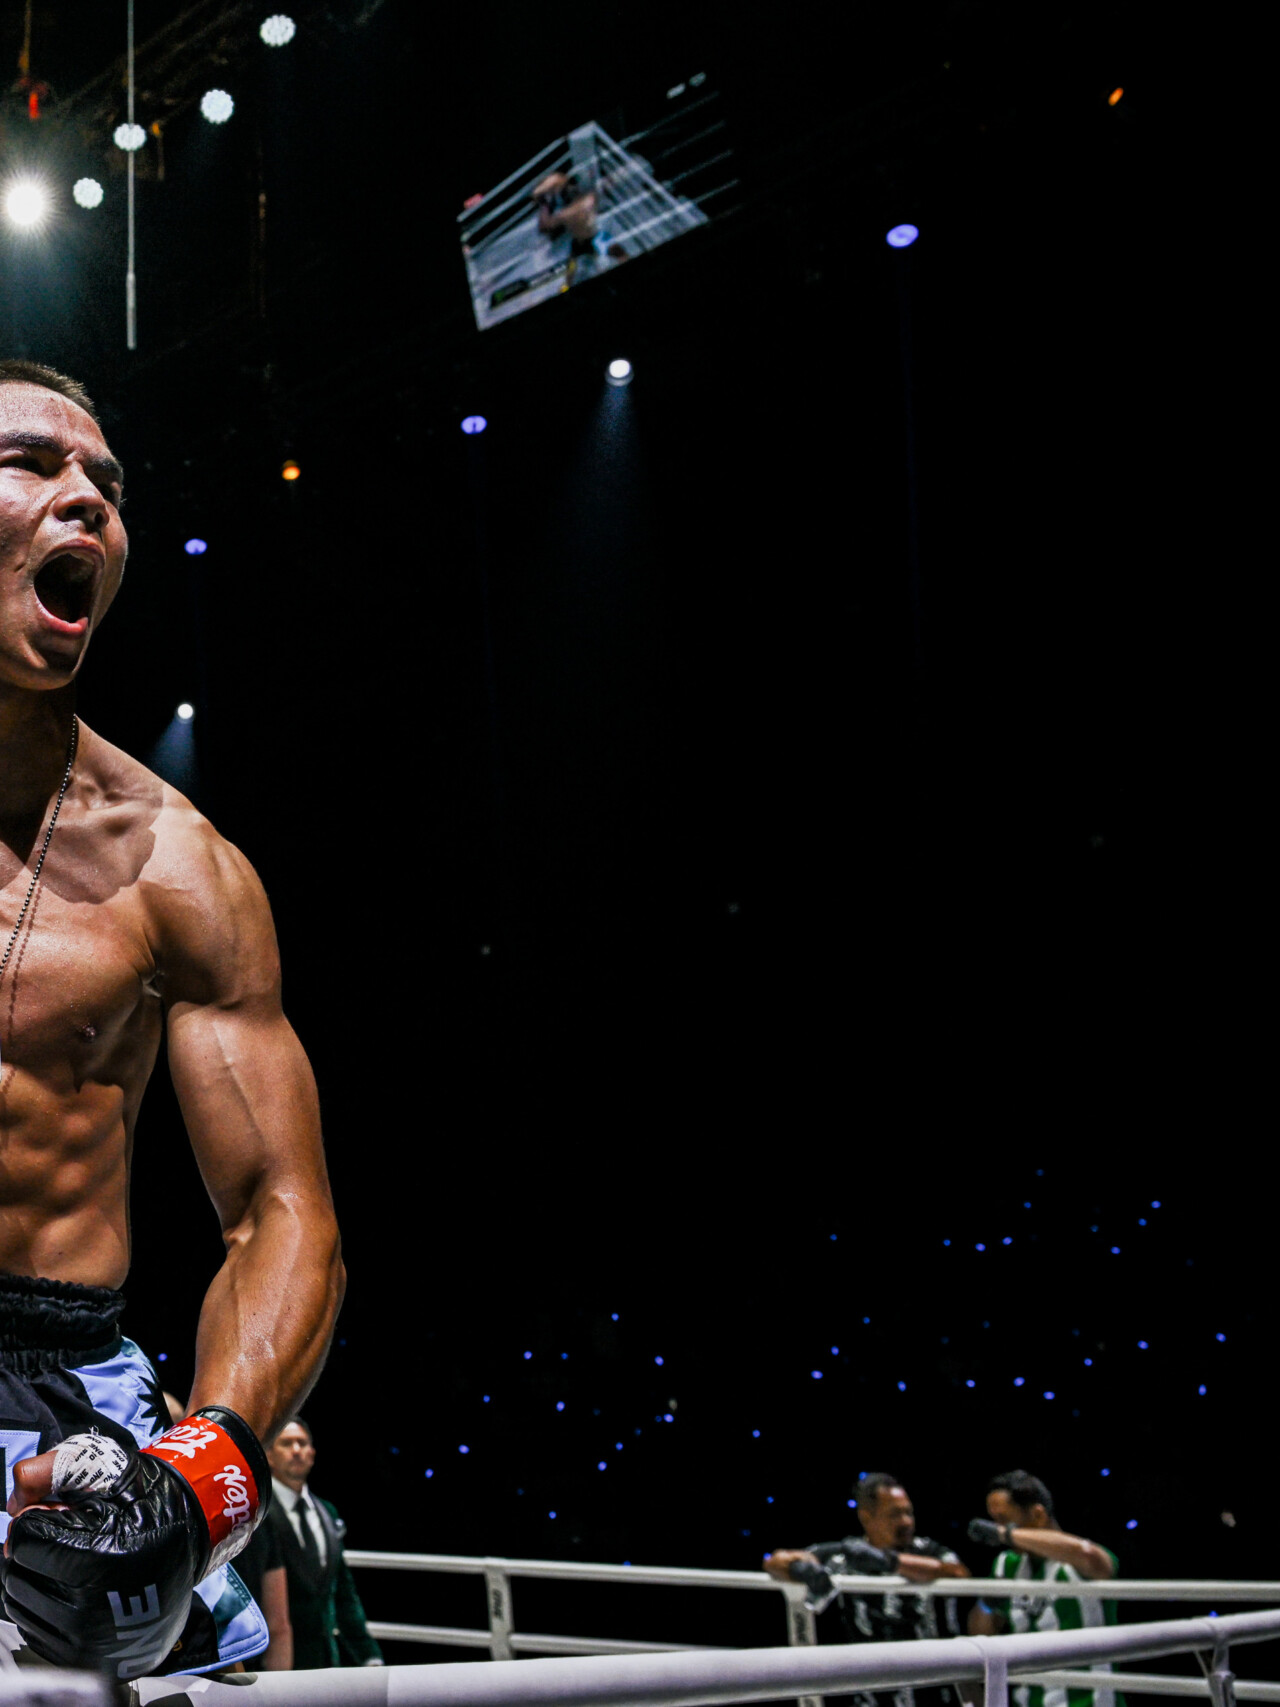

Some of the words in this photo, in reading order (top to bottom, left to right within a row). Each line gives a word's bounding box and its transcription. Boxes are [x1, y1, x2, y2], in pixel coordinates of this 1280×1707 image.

[88, 1443, 104, 1456] ONE
[74, 1468, 89, 1486] ONE
[90, 1468, 104, 1484] ONE
